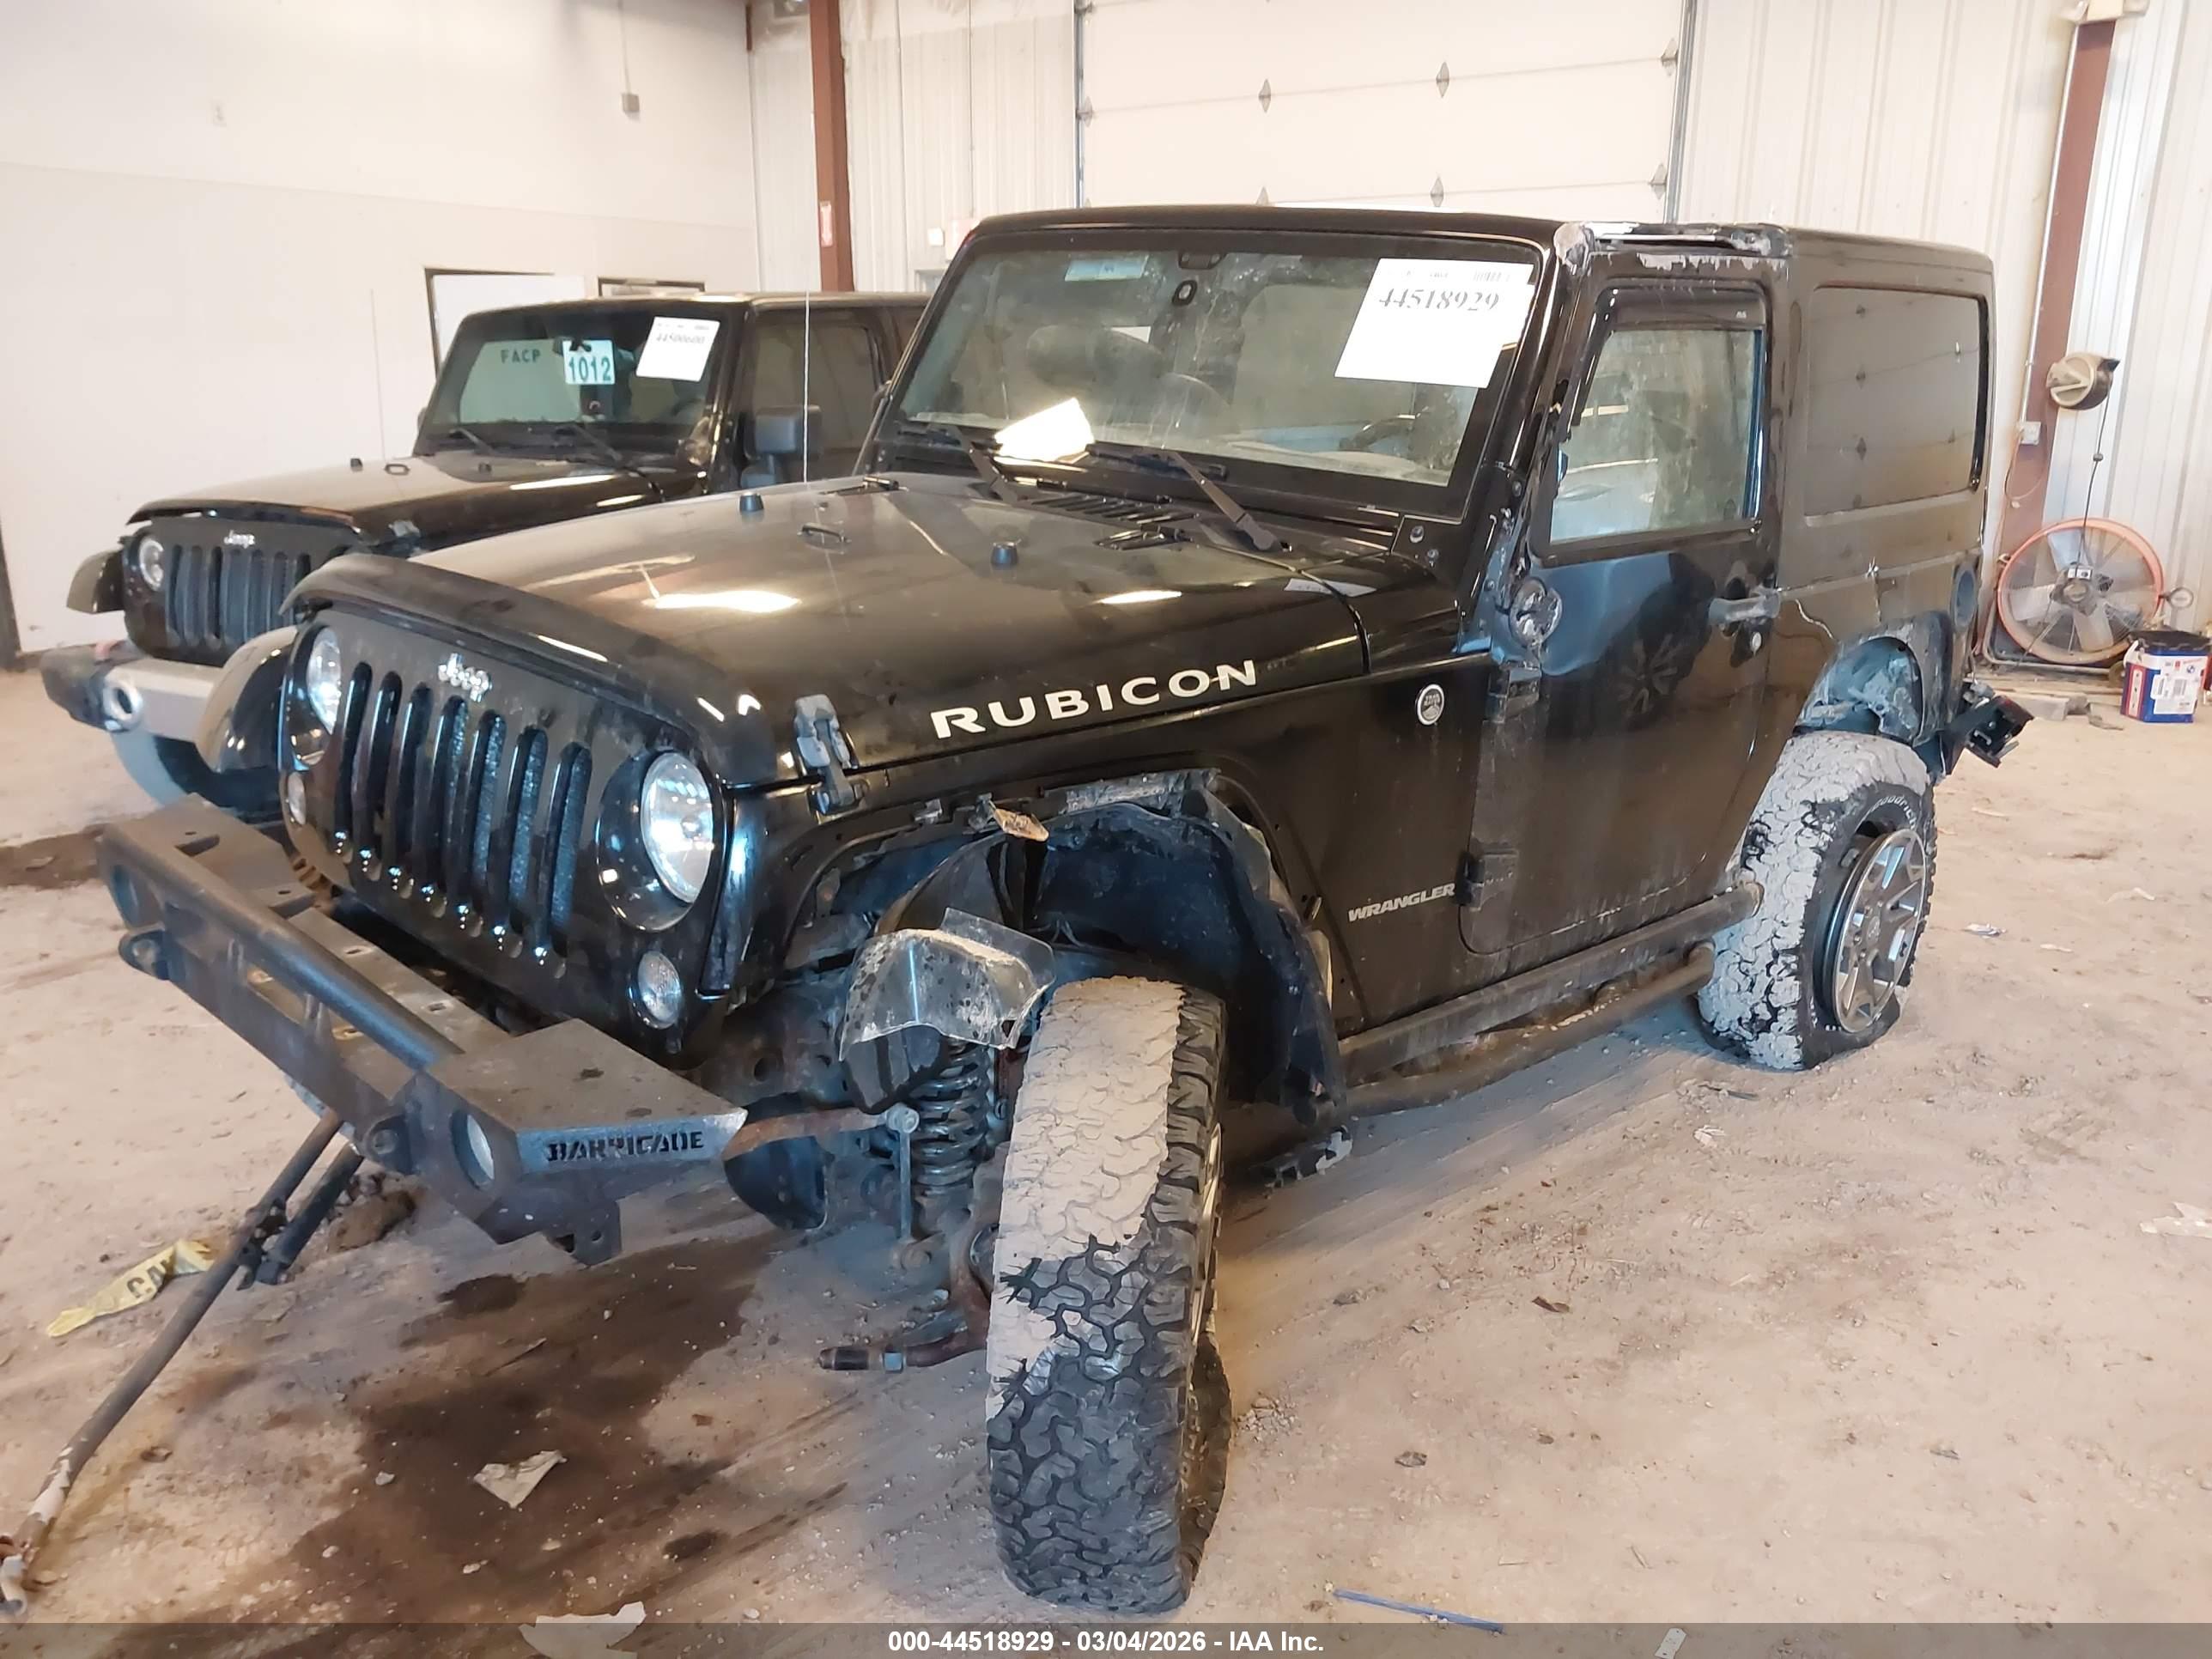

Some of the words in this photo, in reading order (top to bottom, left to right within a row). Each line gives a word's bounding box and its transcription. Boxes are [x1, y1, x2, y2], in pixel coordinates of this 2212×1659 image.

[1379, 289, 1499, 312] 44518929
[501, 349, 541, 363] FACP
[568, 356, 611, 382] 1012
[930, 659, 1256, 739] RUBICON
[1348, 883, 1455, 922] WRANGLER
[547, 1131, 704, 1162] BARRICADE
